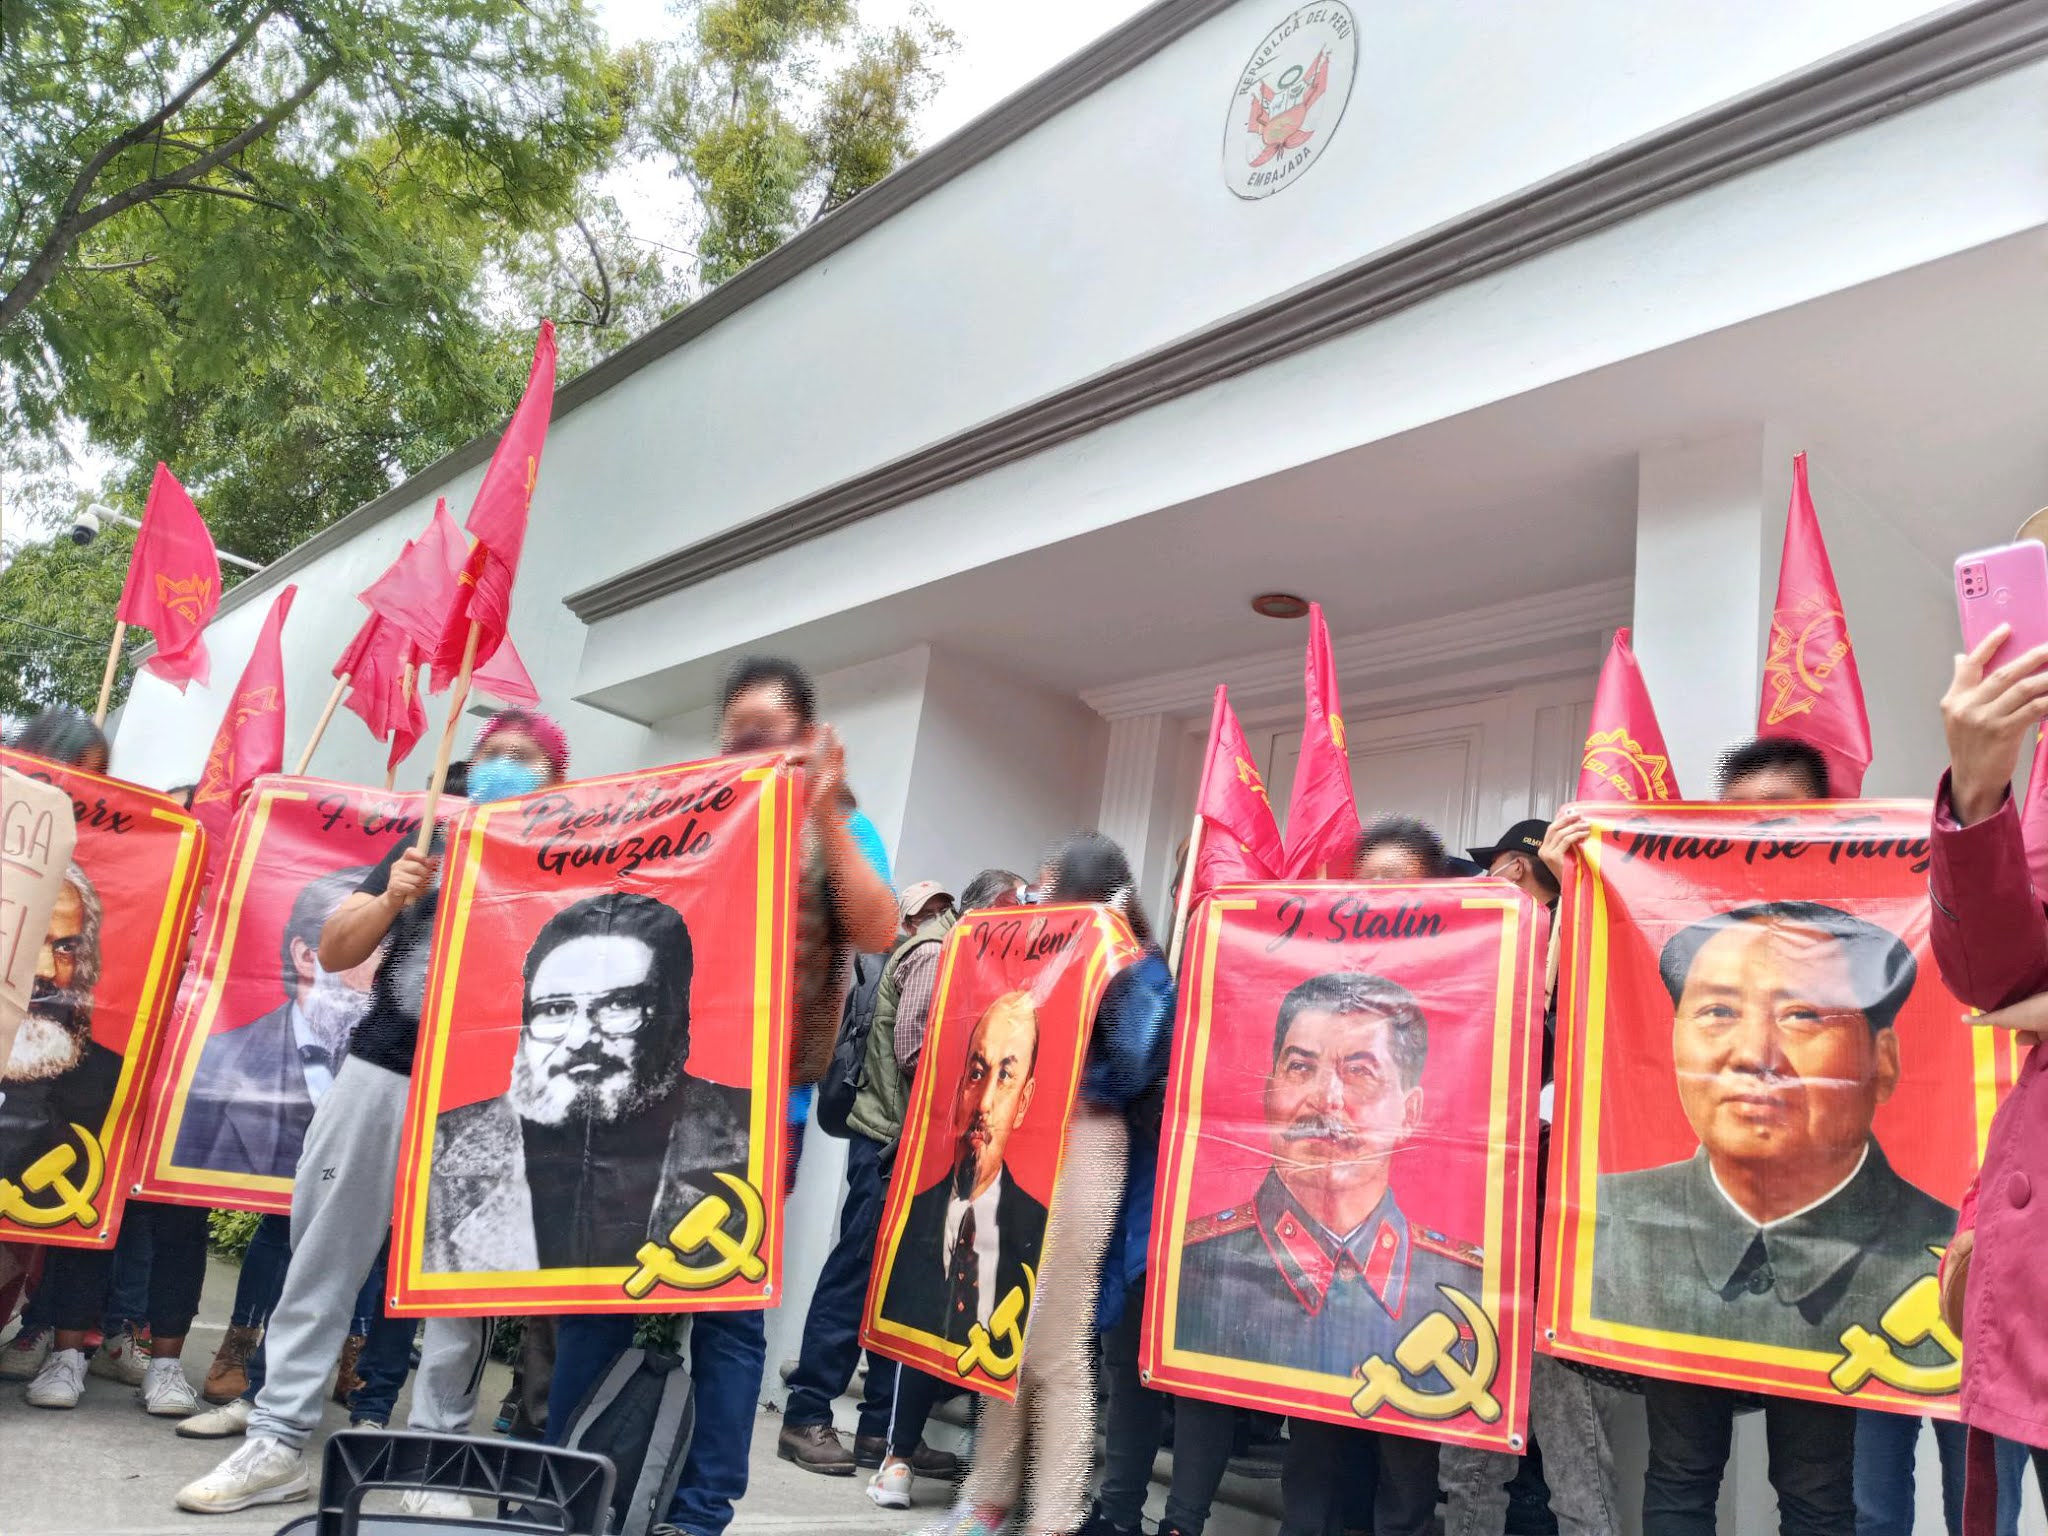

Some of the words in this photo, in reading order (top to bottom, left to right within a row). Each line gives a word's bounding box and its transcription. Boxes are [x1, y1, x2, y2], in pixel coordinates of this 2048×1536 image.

[1306, 9, 1328, 24] DEL
[1247, 147, 1311, 186] EMBAJADA
[522, 779, 738, 842] Presidente
[537, 818, 715, 878] Gonzalo
[1613, 817, 1734, 864] Mao
[1325, 896, 1447, 944] Stalin
